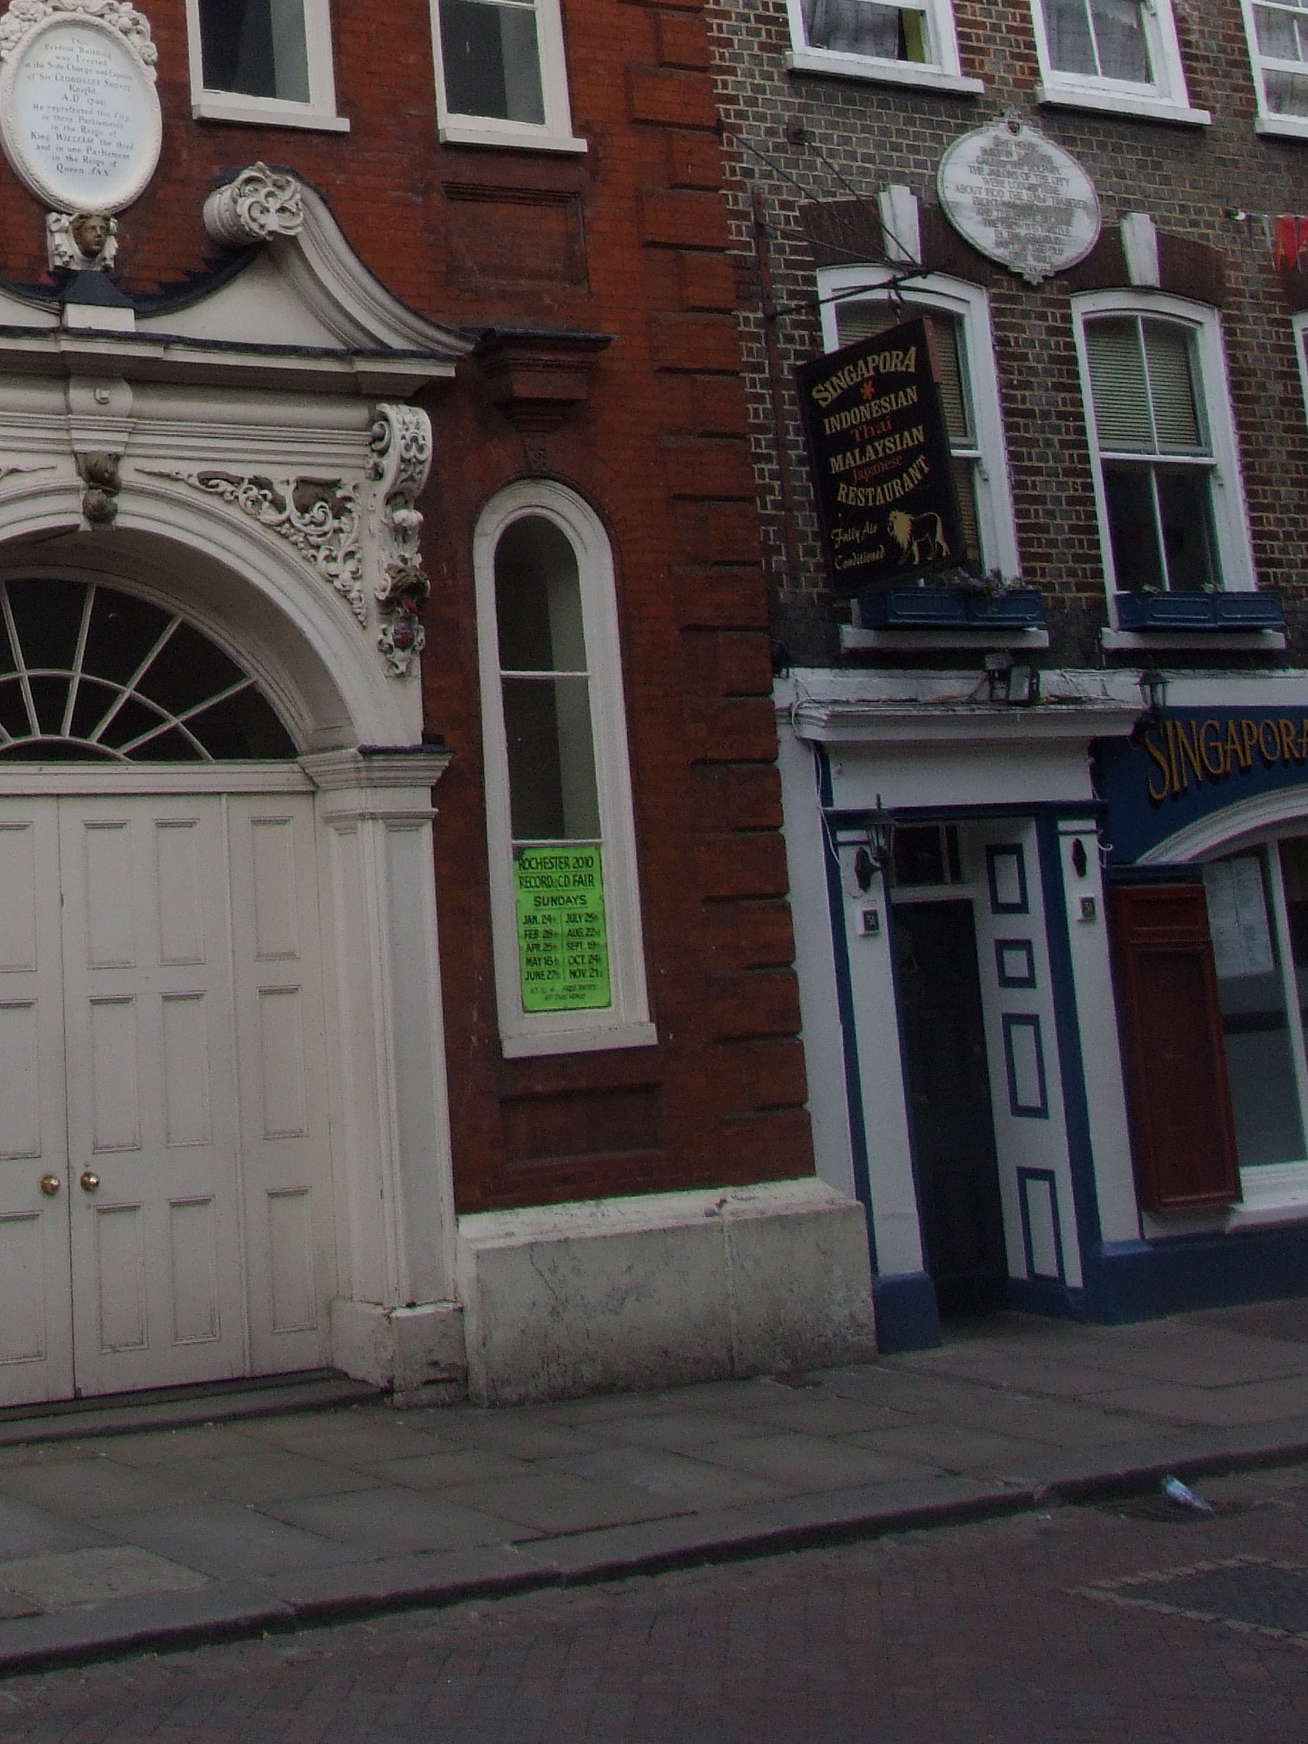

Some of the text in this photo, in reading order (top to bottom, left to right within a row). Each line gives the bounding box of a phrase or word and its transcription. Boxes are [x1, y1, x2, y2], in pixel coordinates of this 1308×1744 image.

[56, 162, 84, 174] Queen
[812, 347, 916, 408] SINGAPORA
[823, 386, 918, 435] INDONESIAN
[853, 416, 892, 442] Thai
[830, 425, 925, 474] MALAYSIAN
[853, 457, 903, 481] Japanese
[838, 456, 930, 506] RESTAURANT
[862, 520, 878, 536] Air
[834, 545, 885, 570] Conditioned
[519, 856, 593, 871] ROCHESTER 2010
[573, 874, 595, 888] FAIR
[534, 895, 587, 907] SUNDAYS
[565, 913, 583, 924] JULY
[525, 956, 542, 967] MAY
[524, 970, 545, 981] JUNE
